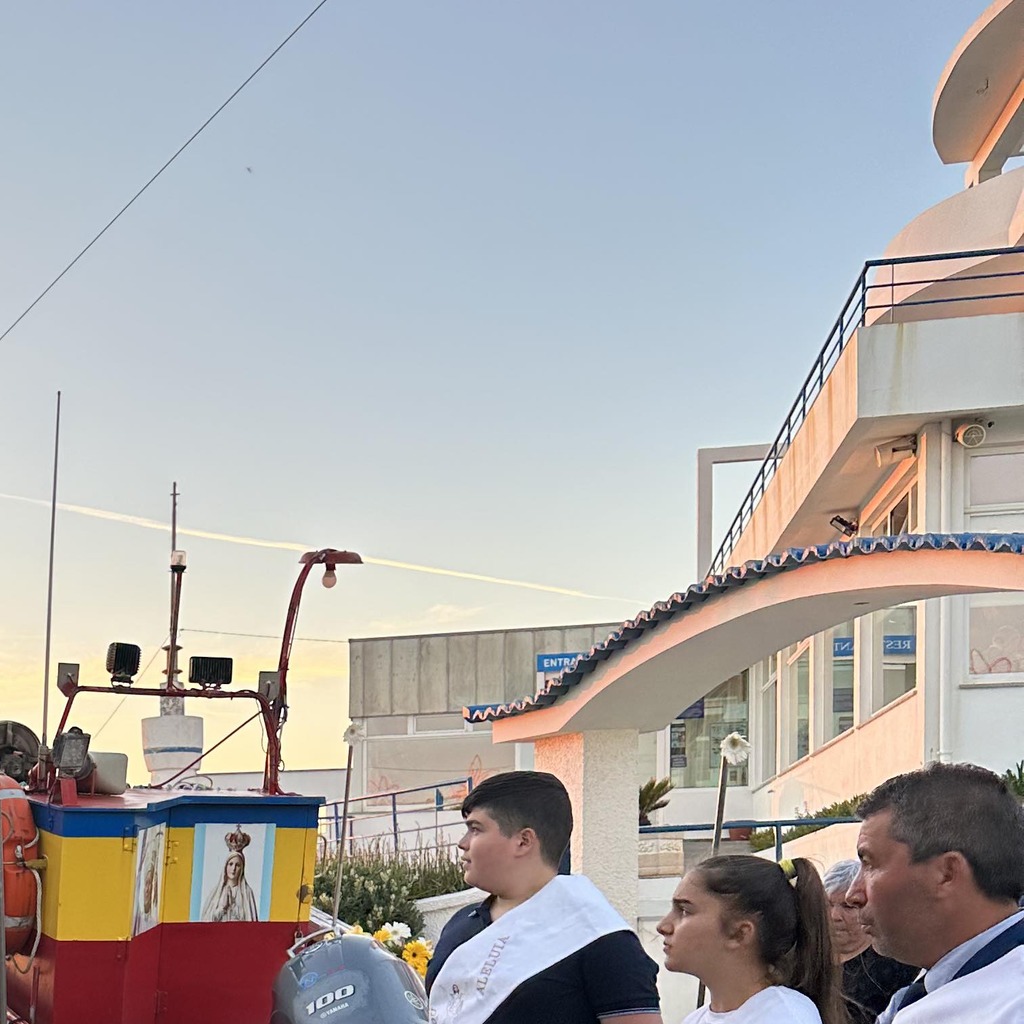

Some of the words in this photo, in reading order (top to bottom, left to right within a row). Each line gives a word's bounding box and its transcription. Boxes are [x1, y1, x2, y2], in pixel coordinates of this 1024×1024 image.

[476, 935, 511, 996] ALELUIA
[305, 984, 356, 1016] 100
[326, 1002, 350, 1016] YAMAHA
